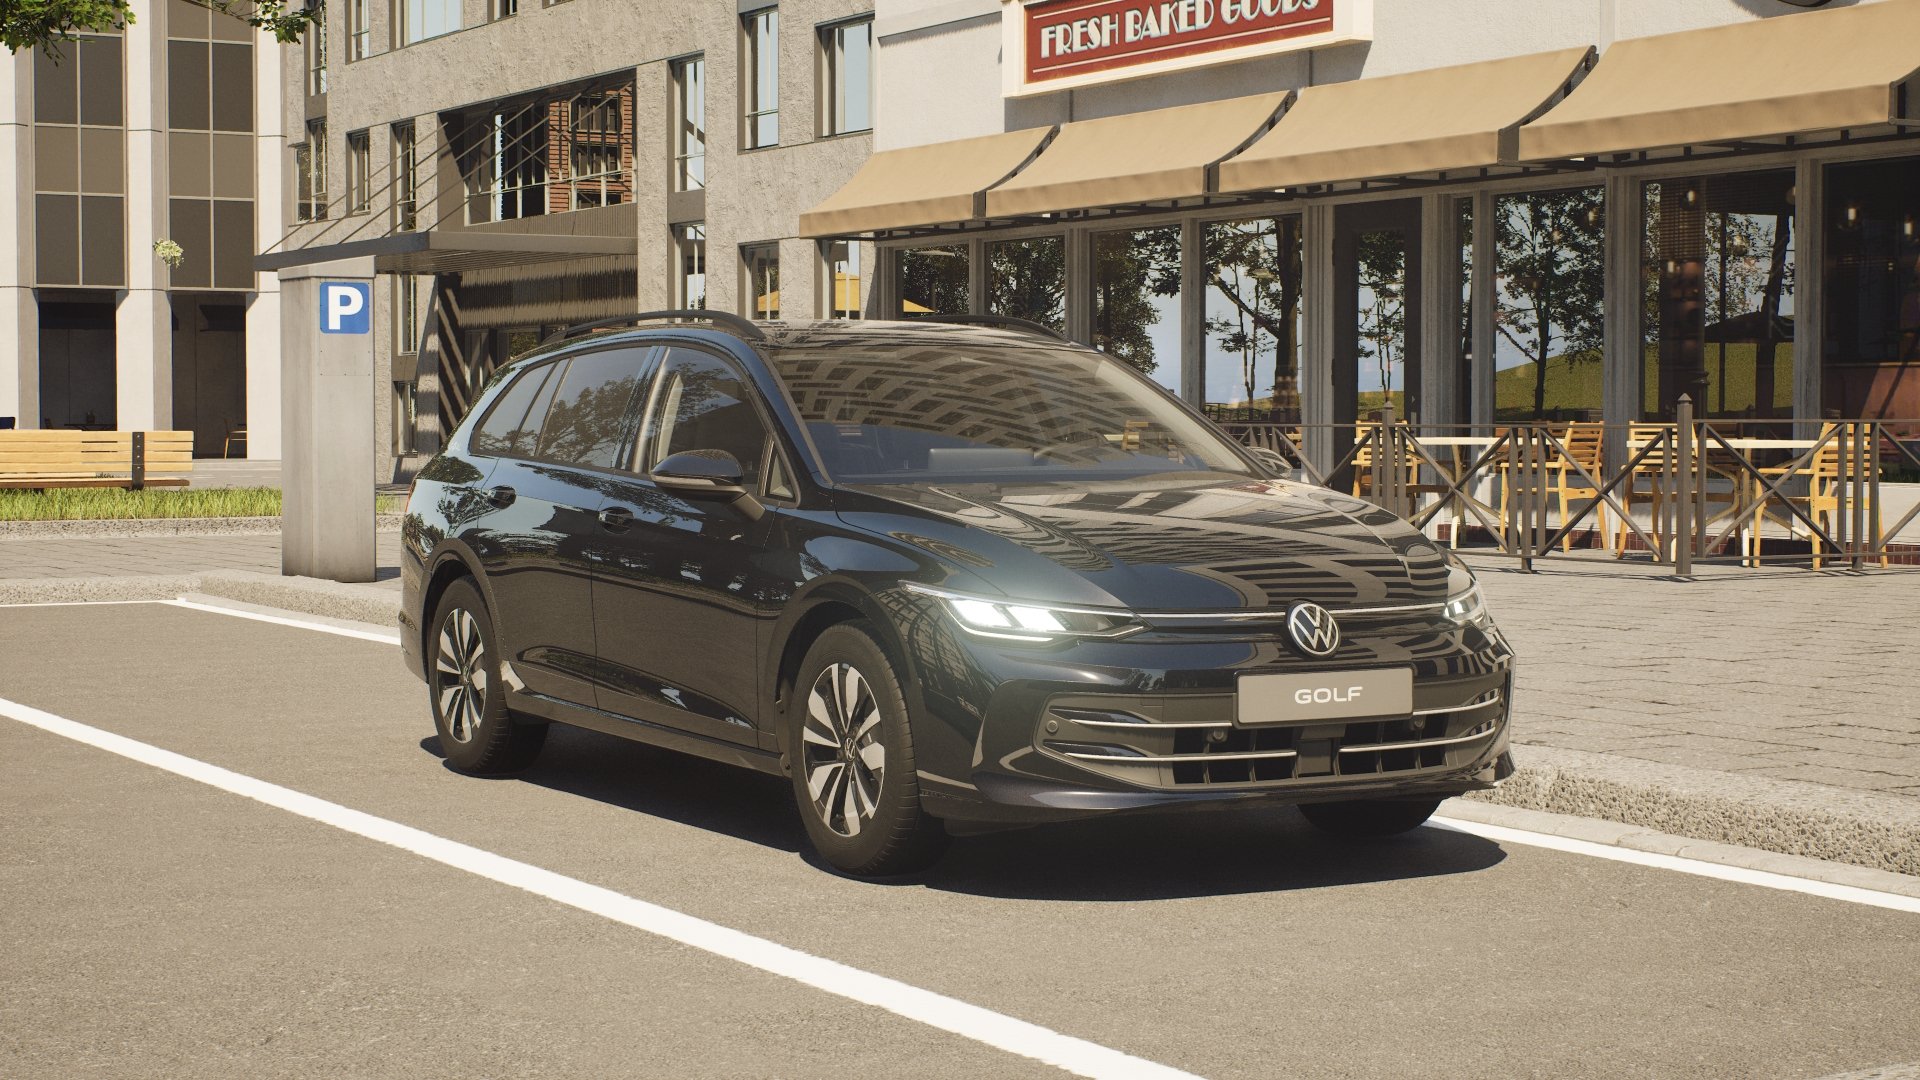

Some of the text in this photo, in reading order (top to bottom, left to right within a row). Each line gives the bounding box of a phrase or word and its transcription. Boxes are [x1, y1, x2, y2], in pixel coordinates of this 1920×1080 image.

[1040, 13, 1119, 59] FRESH
[1124, 0, 1215, 43] BAKED
[328, 286, 363, 330] P
[1290, 603, 1340, 654] VW
[1294, 685, 1364, 704] GOLF
